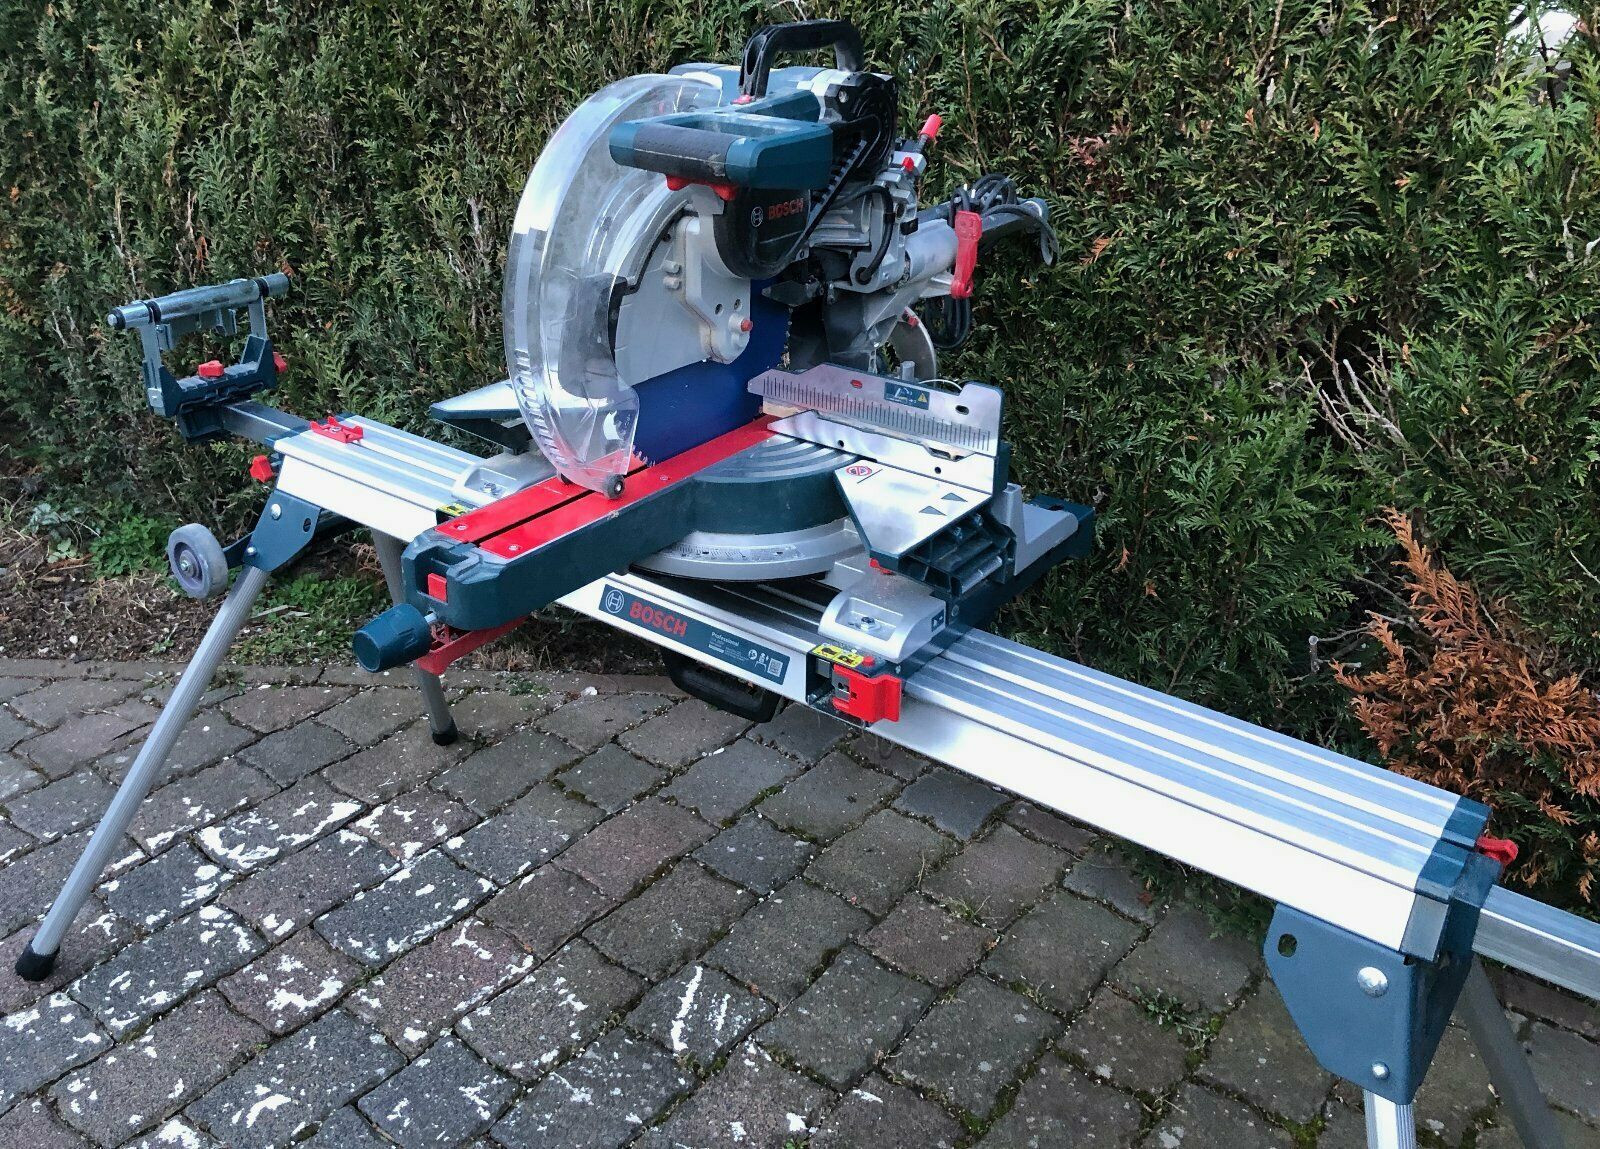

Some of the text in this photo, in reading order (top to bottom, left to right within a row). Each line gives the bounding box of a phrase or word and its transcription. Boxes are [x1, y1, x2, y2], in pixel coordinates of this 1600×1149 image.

[768, 198, 804, 220] BOSCH
[629, 601, 688, 637] BOSCH
[711, 631, 740, 647] Professional
